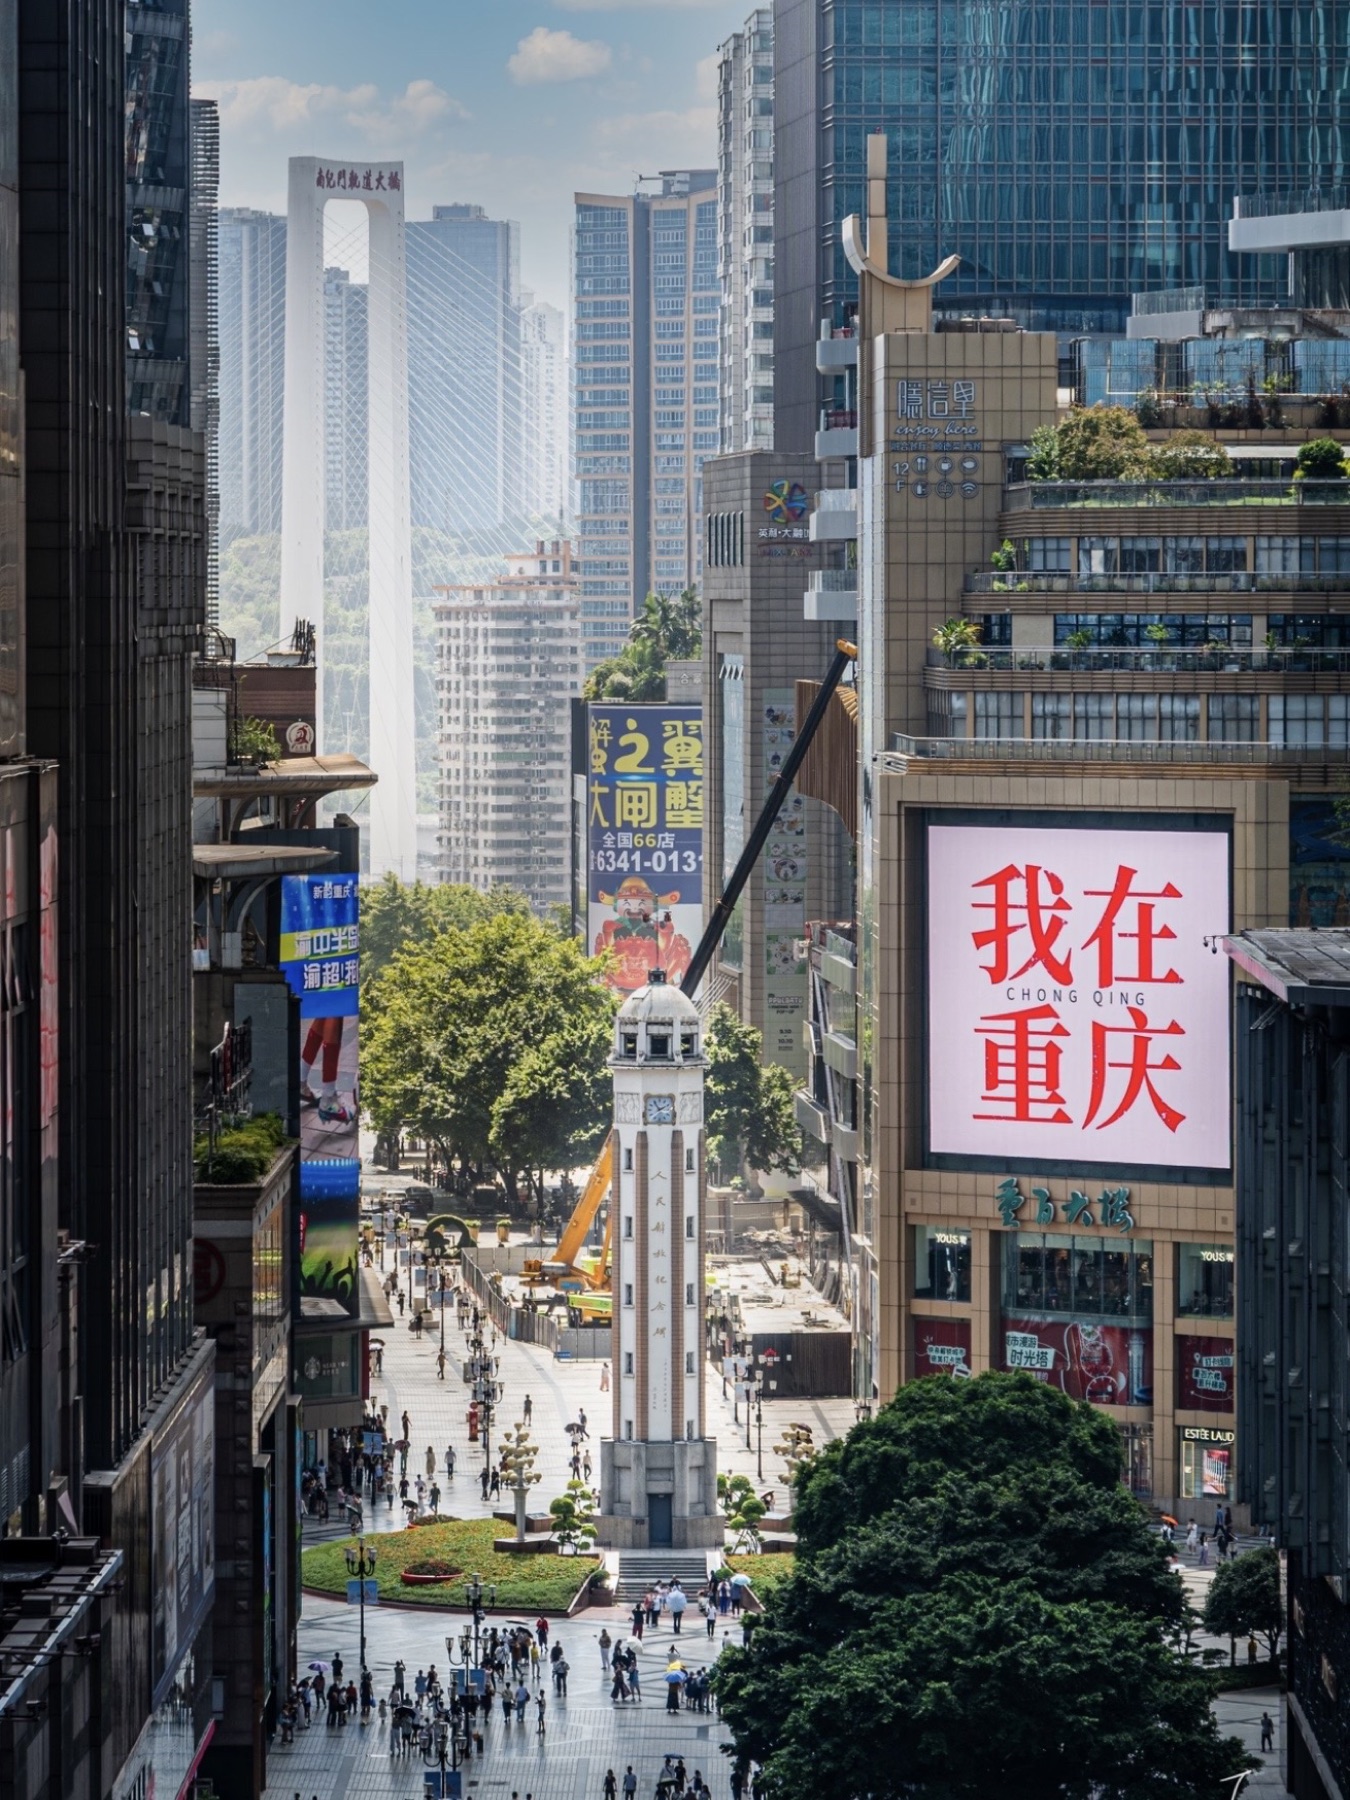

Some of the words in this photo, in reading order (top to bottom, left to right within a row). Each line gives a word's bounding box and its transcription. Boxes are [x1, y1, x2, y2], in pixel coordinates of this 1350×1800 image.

[895, 424, 940, 439] enjoy
[944, 421, 977, 435] here
[893, 462, 909, 475] 12
[896, 480, 905, 493] F
[602, 831, 675, 849] 全国66店
[971, 864, 1184, 988] 我在
[1006, 987, 1078, 1003] CHONG
[1093, 990, 1145, 1006] QING
[972, 1004, 1186, 1133] 重庆
[996, 1177, 1134, 1233] 重百大楼
[1010, 1349, 1049, 1367] 时光塔
